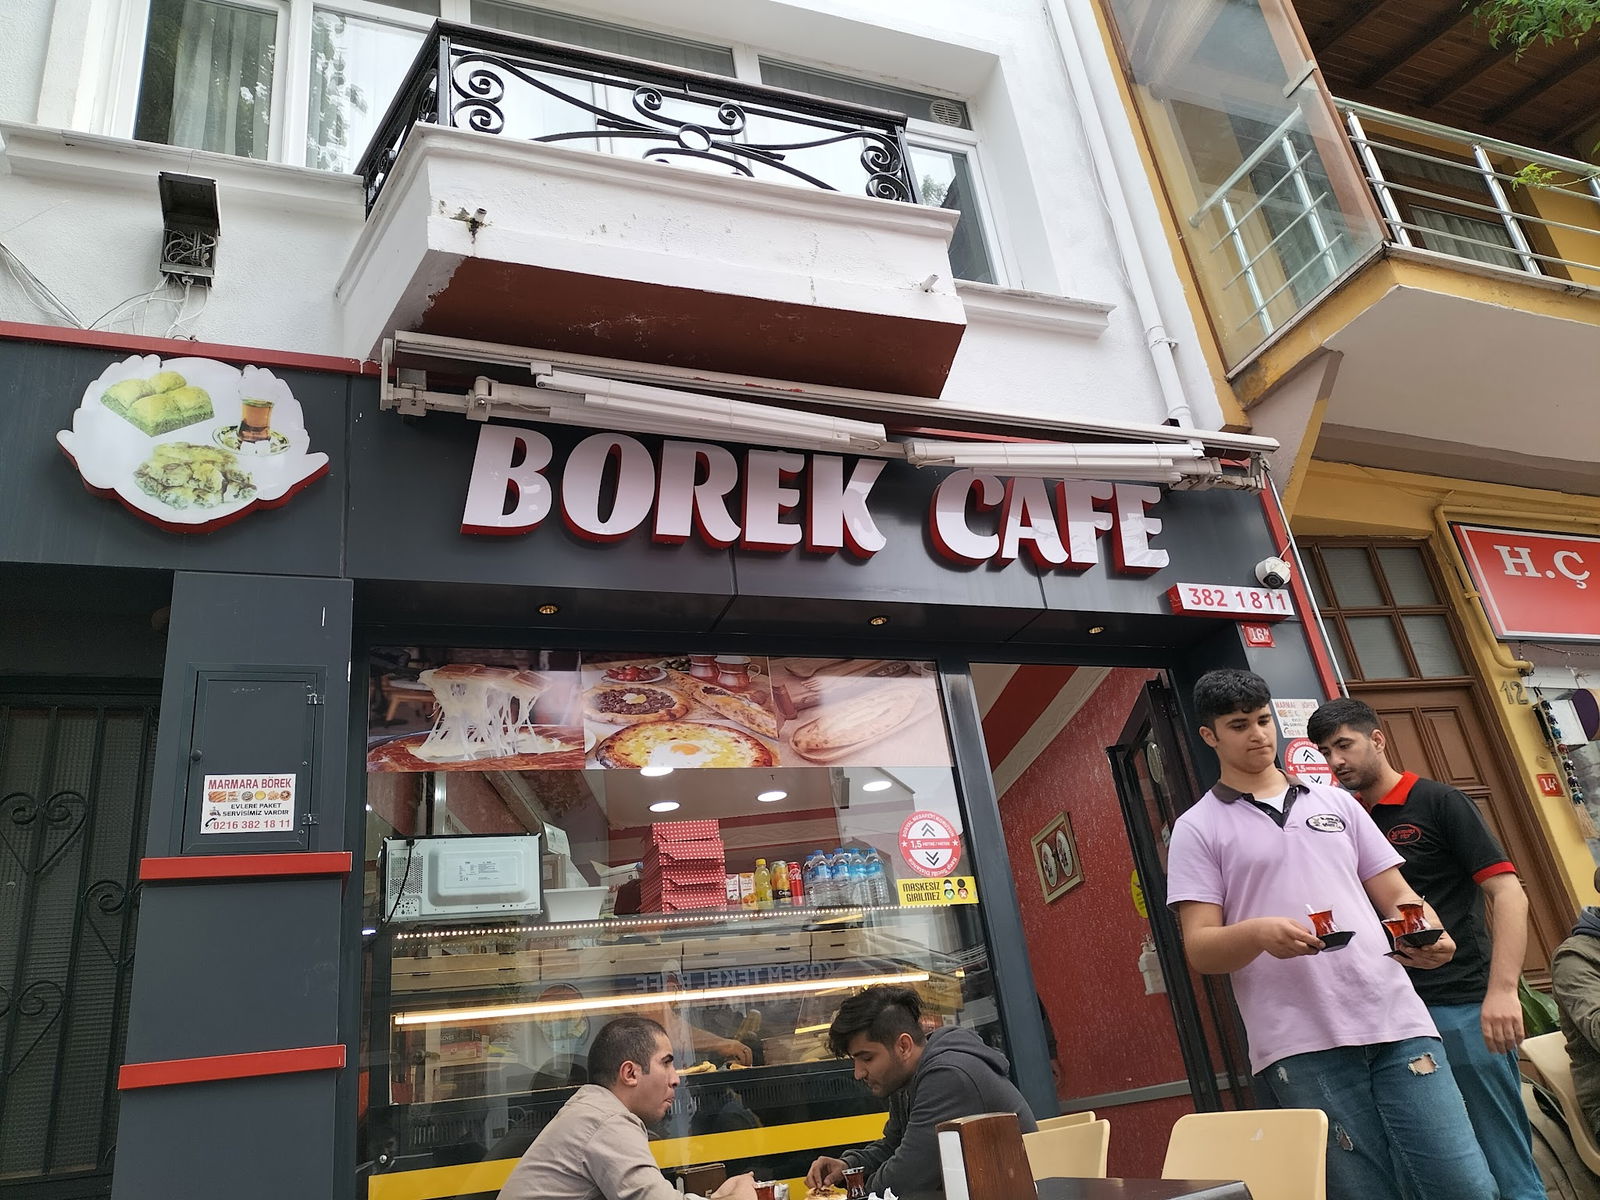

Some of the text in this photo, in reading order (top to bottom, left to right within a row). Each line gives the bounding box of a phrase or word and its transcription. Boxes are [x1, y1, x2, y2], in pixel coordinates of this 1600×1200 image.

[461, 424, 1171, 574] BOREK CAFE
[1493, 544, 1591, 590] H.Ç
[1188, 587, 1287, 611] 382 1811
[1500, 680, 1529, 705] 12
[208, 775, 292, 790] MARMARA BÖREK
[213, 819, 291, 830] 0216 382 18 11
[910, 840, 922, 849] 1,5
